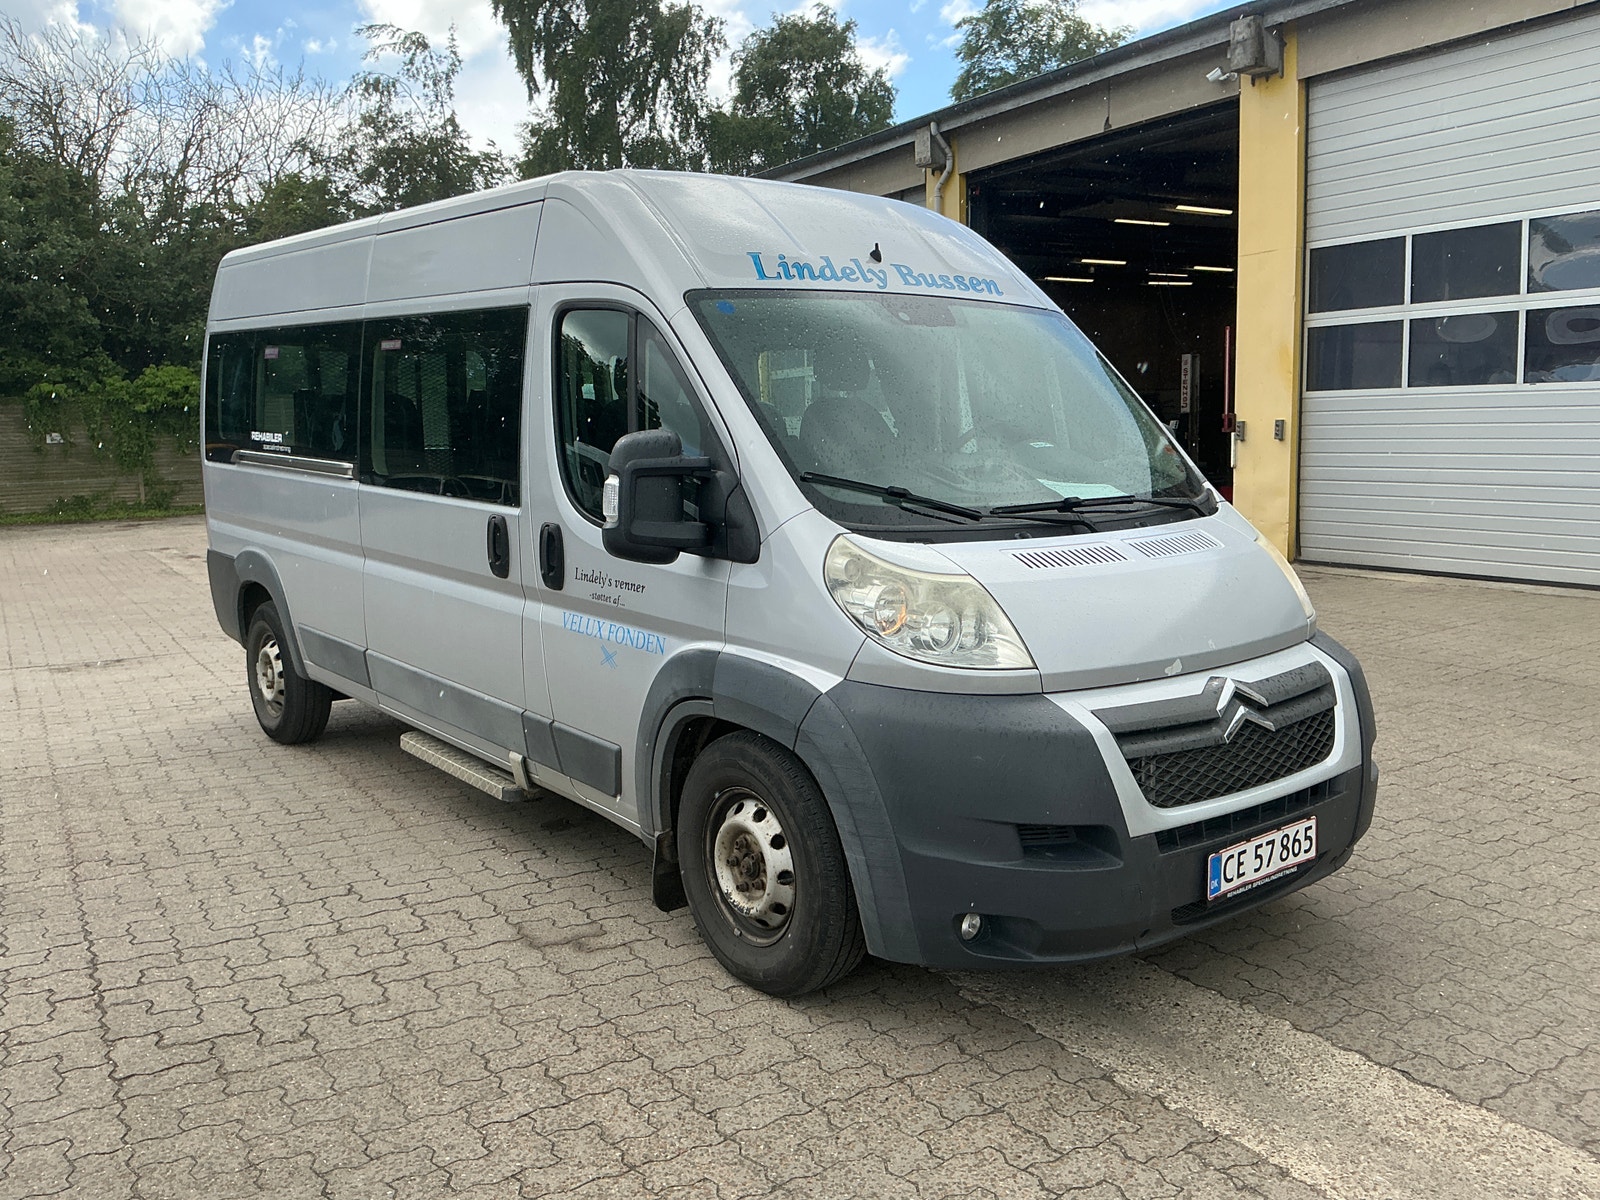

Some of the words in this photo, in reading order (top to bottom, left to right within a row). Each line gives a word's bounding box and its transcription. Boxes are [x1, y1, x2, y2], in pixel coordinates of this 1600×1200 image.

[747, 252, 887, 289] Lindely
[890, 264, 1004, 296] Bussen
[575, 567, 612, 589] Lindely's
[615, 579, 646, 594] venner
[562, 611, 606, 640] VELUX
[607, 623, 667, 655] FONDEN
[1223, 849, 1247, 883] CE
[1254, 838, 1276, 873] 57
[1280, 825, 1313, 862] 865
